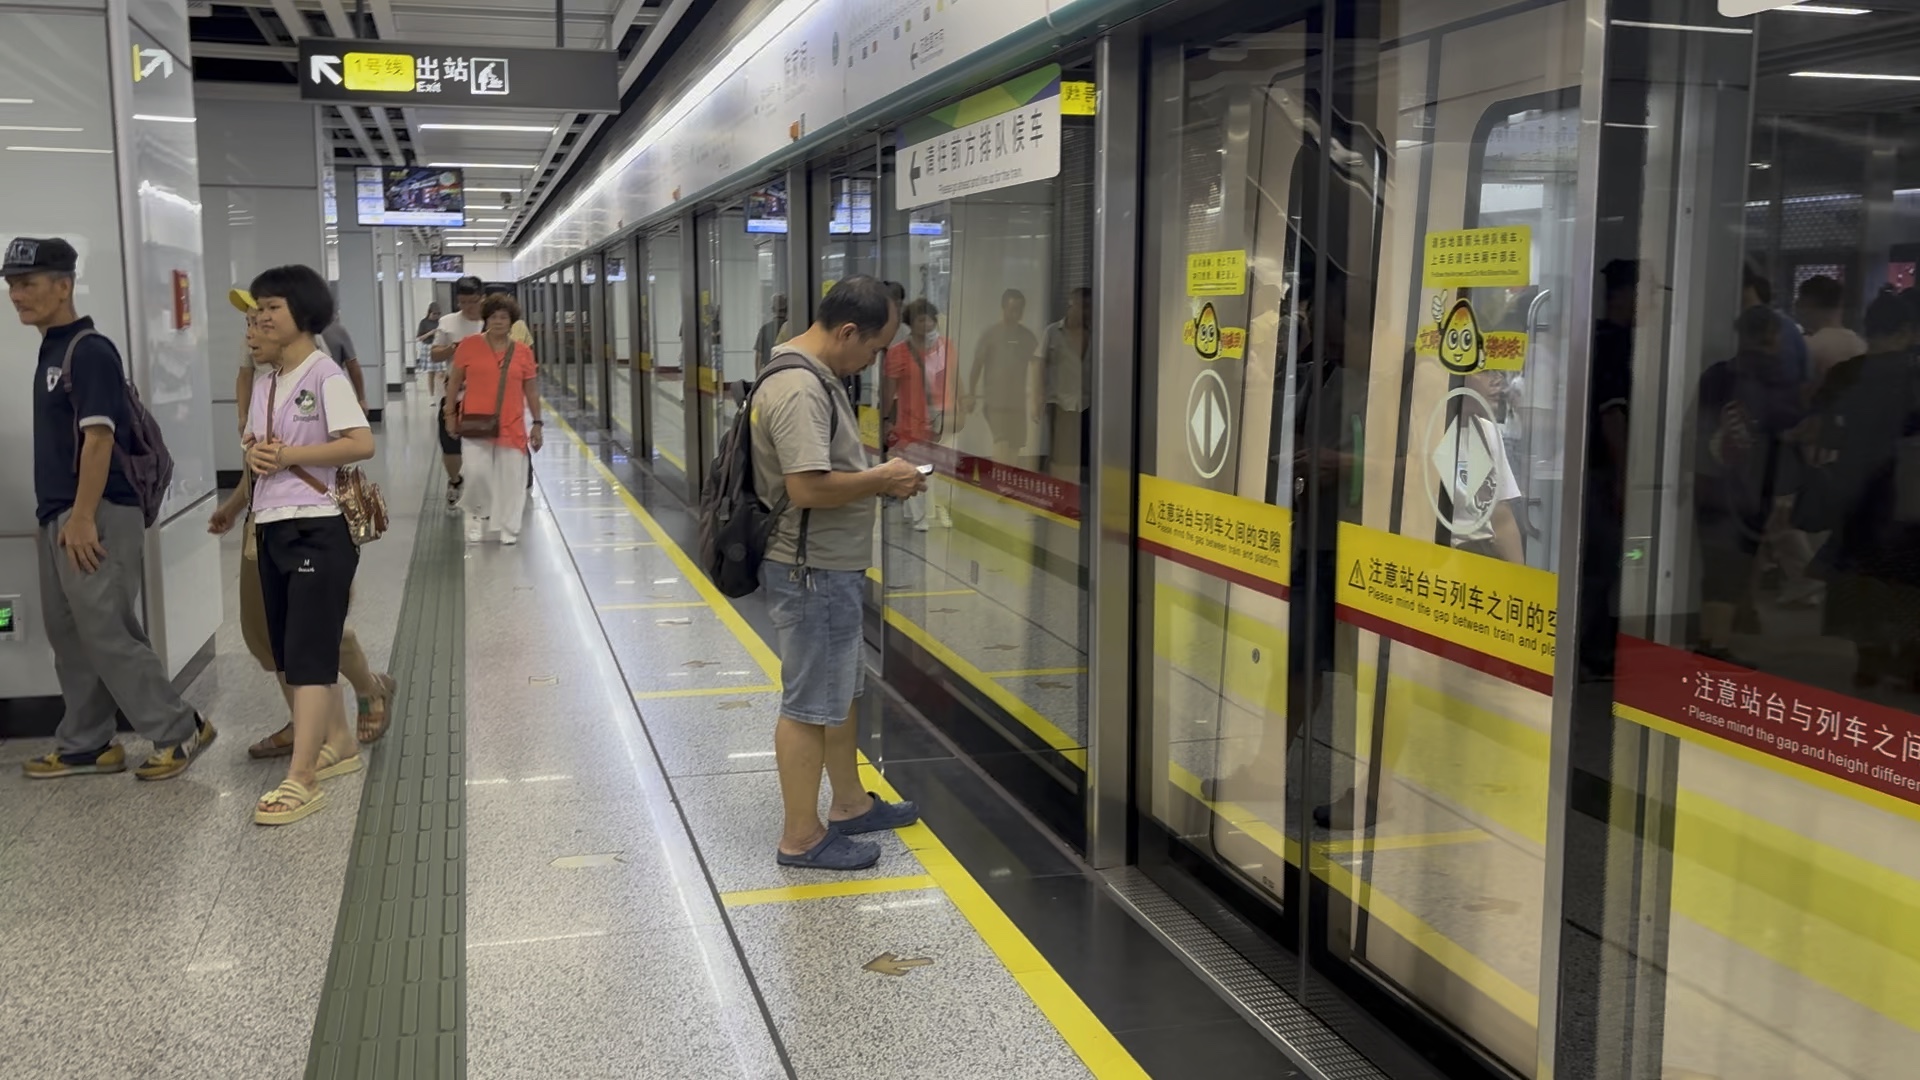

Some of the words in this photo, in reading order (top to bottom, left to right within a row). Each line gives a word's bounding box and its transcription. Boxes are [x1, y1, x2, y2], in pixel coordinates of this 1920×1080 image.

[354, 57, 404, 76] 1号线
[416, 55, 469, 82] 出站
[416, 81, 442, 93] Exit
[925, 108, 1044, 176] 请往前方排队候车
[1157, 500, 1282, 554] 注意站台与列车之间的空隙
[1368, 586, 1393, 604] Please
[1396, 594, 1415, 611] mind
[1417, 600, 1431, 616] the
[1433, 608, 1450, 624] gap
[1452, 612, 1490, 635] between
[1493, 626, 1515, 644] train
[1518, 632, 1537, 651] and
[1689, 704, 1725, 728] Please
[1727, 718, 1754, 737] mind
[1756, 727, 1775, 743] the
[1776, 736, 1800, 754] gap
[1801, 742, 1825, 760] and
[1827, 749, 1869, 776] height
[1693, 670, 1920, 763] 注意站台与列车之间
